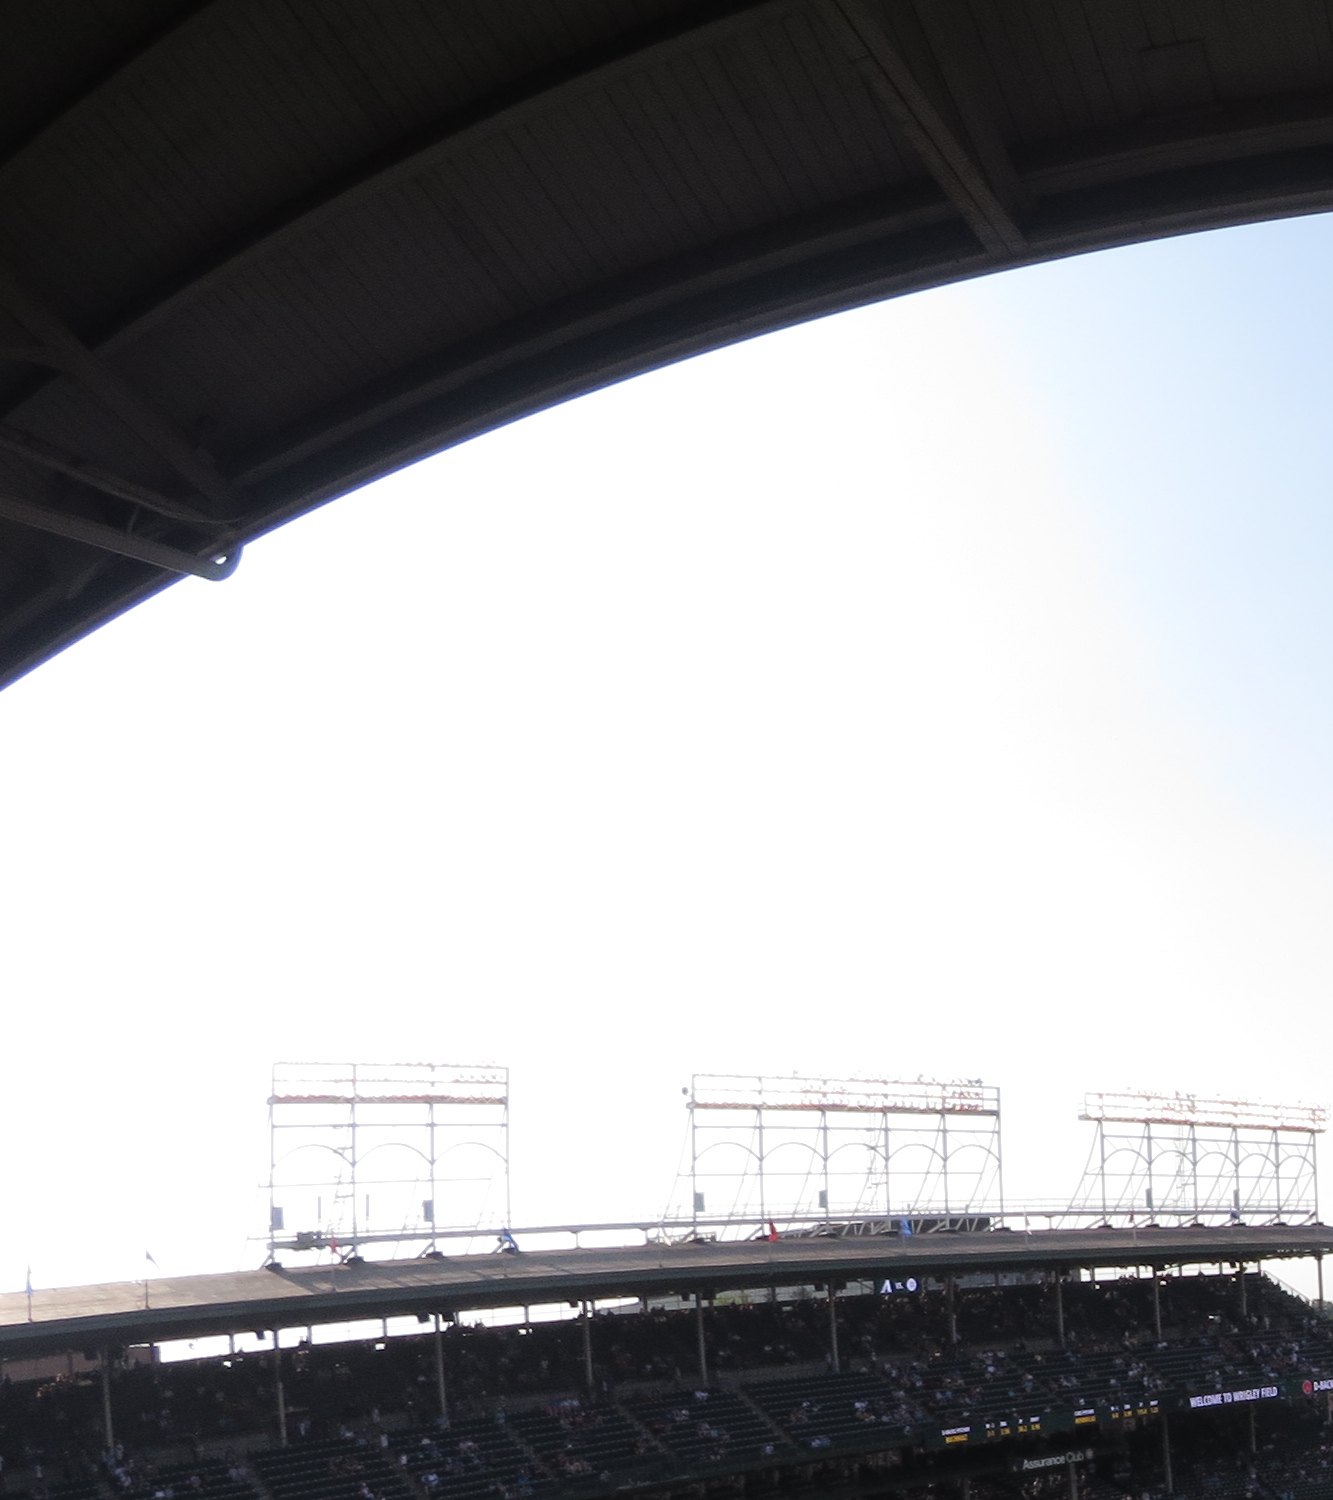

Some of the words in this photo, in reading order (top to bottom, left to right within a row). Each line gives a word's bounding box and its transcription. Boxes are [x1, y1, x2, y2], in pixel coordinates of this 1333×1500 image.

[1189, 1392, 1223, 1408] WELCOME
[1233, 1389, 1260, 1402] WRIGLEY
[1260, 1386, 1278, 1399] FIELD
[1022, 1454, 1065, 1471] Assurance
